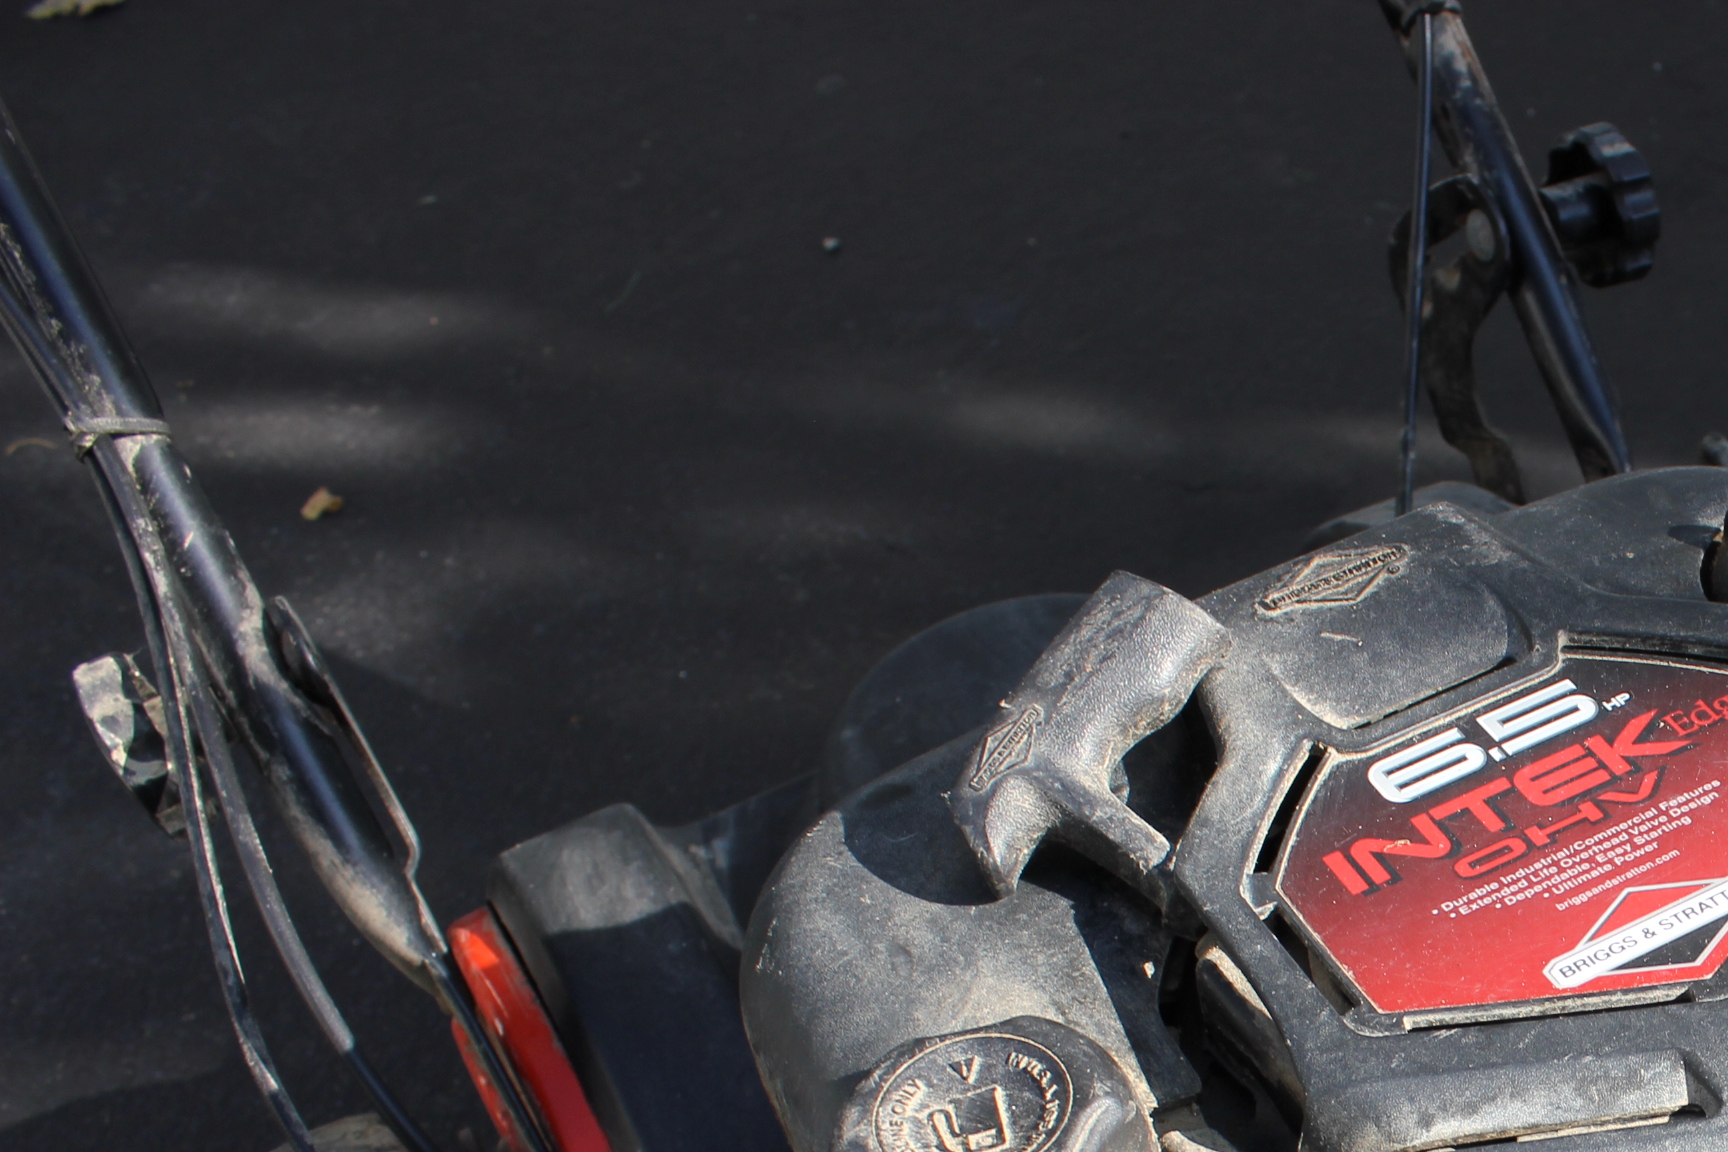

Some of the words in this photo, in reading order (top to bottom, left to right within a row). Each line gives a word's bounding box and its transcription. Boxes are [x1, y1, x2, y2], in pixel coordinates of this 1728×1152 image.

[1367, 678, 1599, 803] 6.5
[1601, 692, 1633, 712] HP
[1322, 708, 1694, 896] INTEK
[1441, 881, 1499, 912] Durable
[1500, 807, 1658, 883] Industrial/Commercial
[1659, 779, 1721, 812] Features
[1453, 769, 1665, 878] OHV
[1460, 878, 1528, 915] Extended
[1530, 866, 1558, 882] Life
[1560, 831, 1628, 868] Overhead
[1624, 813, 1670, 837] Valve
[1670, 791, 1719, 818] Design
[1504, 862, 1597, 907] Dependable,
[1596, 843, 1633, 866] Easy
[1635, 815, 1692, 846] Starting
[1551, 863, 1613, 895] Ultimate
[1615, 842, 1659, 866] Power
[1555, 849, 1681, 912] briggsandstratton.com
[1559, 935, 1638, 979] BRIGGS
[1642, 928, 1657, 940] &
[891, 1077, 926, 1116] ONLY
